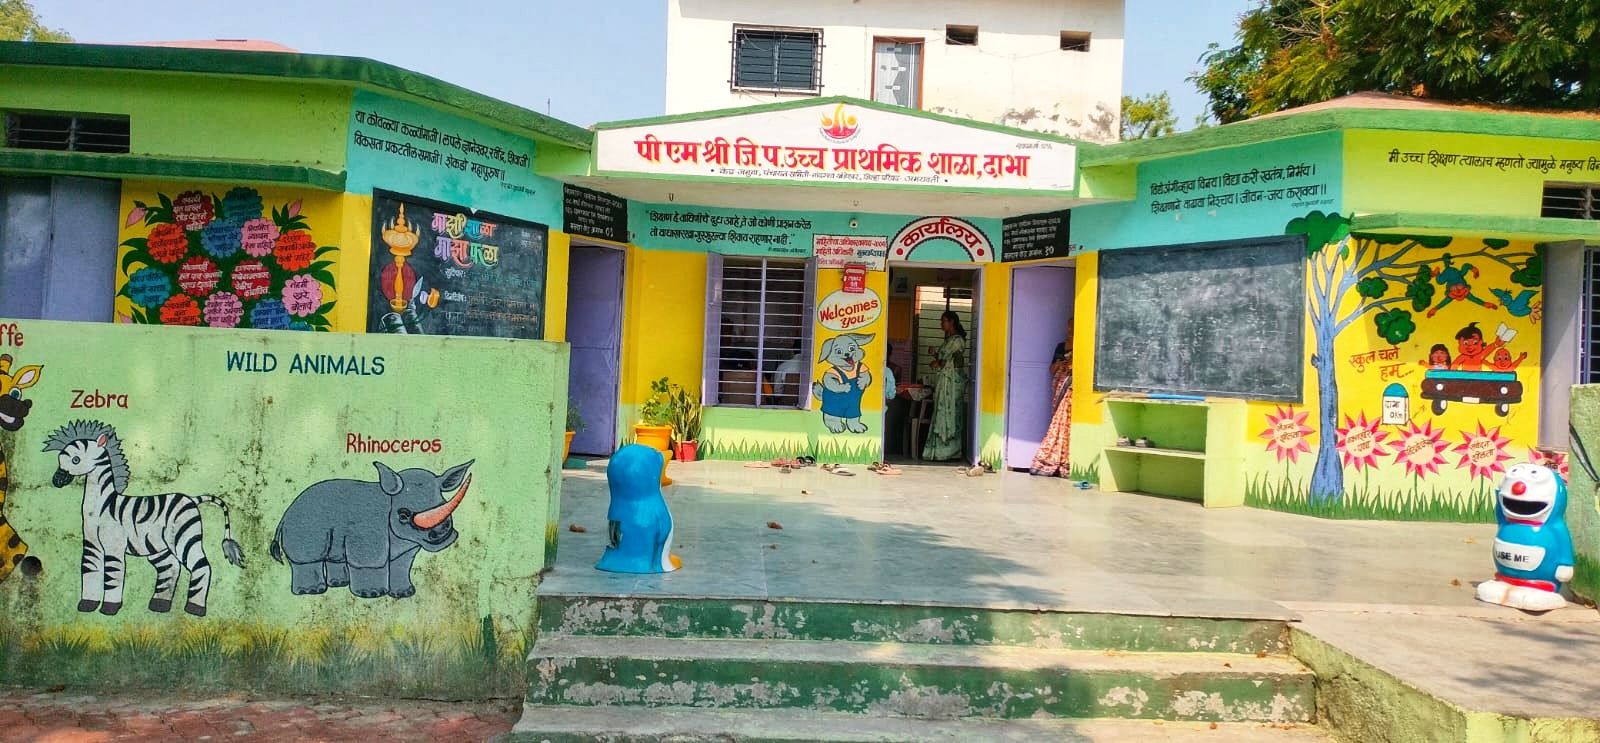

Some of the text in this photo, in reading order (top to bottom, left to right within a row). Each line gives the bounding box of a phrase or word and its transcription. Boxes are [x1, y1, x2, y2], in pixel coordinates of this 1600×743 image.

[634, 133, 663, 164] पी
[664, 140, 701, 164] एम
[702, 136, 731, 166] श्री
[832, 142, 922, 174] प्राथमिक
[1388, 148, 1400, 164] मी
[1401, 152, 1425, 165] उच्च
[1427, 149, 1460, 168] शिक्षण
[1495, 153, 1525, 172] म्हणतो
[1526, 154, 1557, 175] ज्यामुळे
[1559, 159, 1586, 175] मनुष्य
[900, 216, 983, 249] कार्यालय
[820, 299, 878, 322] Welcomes
[0, 323, 23, 346] ffe
[227, 350, 385, 375] WILD ANIMALS
[70, 389, 128, 409] Zebra
[346, 432, 442, 453] Rhinoceros
[1513, 554, 1529, 562] ME
